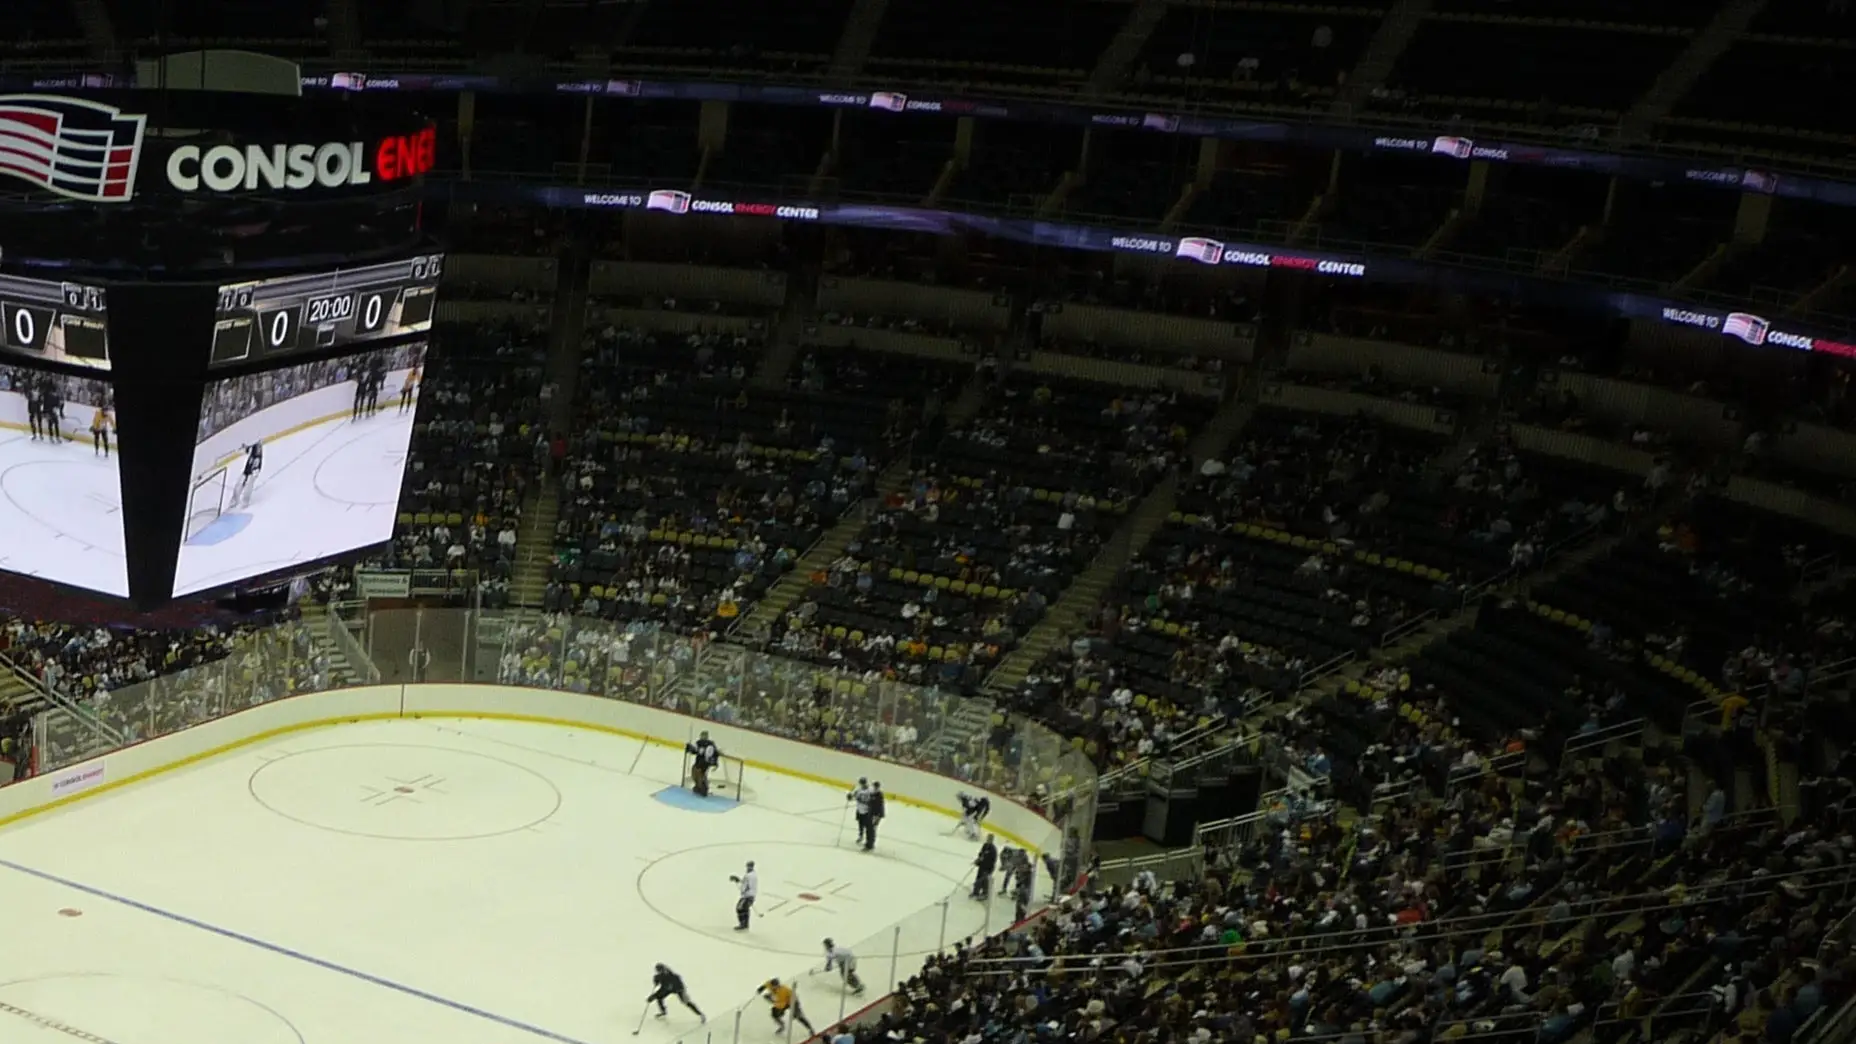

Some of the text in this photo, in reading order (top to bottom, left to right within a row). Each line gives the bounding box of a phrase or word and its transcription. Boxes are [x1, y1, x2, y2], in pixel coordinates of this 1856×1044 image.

[166, 141, 371, 192] CONSOL
[583, 193, 628, 207] WELCOME
[628, 195, 642, 207] TO
[692, 199, 735, 214] CONSOL
[776, 205, 819, 220] CENTER
[1111, 235, 1157, 251] WELCOME
[1158, 240, 1172, 253] TO
[1223, 249, 1271, 267] CONSOL
[1317, 259, 1366, 277] CENTER
[15, 308, 34, 344] 0
[309, 295, 352, 322] 20:00
[364, 294, 382, 329] 0
[271, 310, 289, 347] 0
[1662, 307, 1707, 327] WELCOME
[1706, 315, 1720, 329] TO
[1767, 329, 1813, 351] CONSOL
